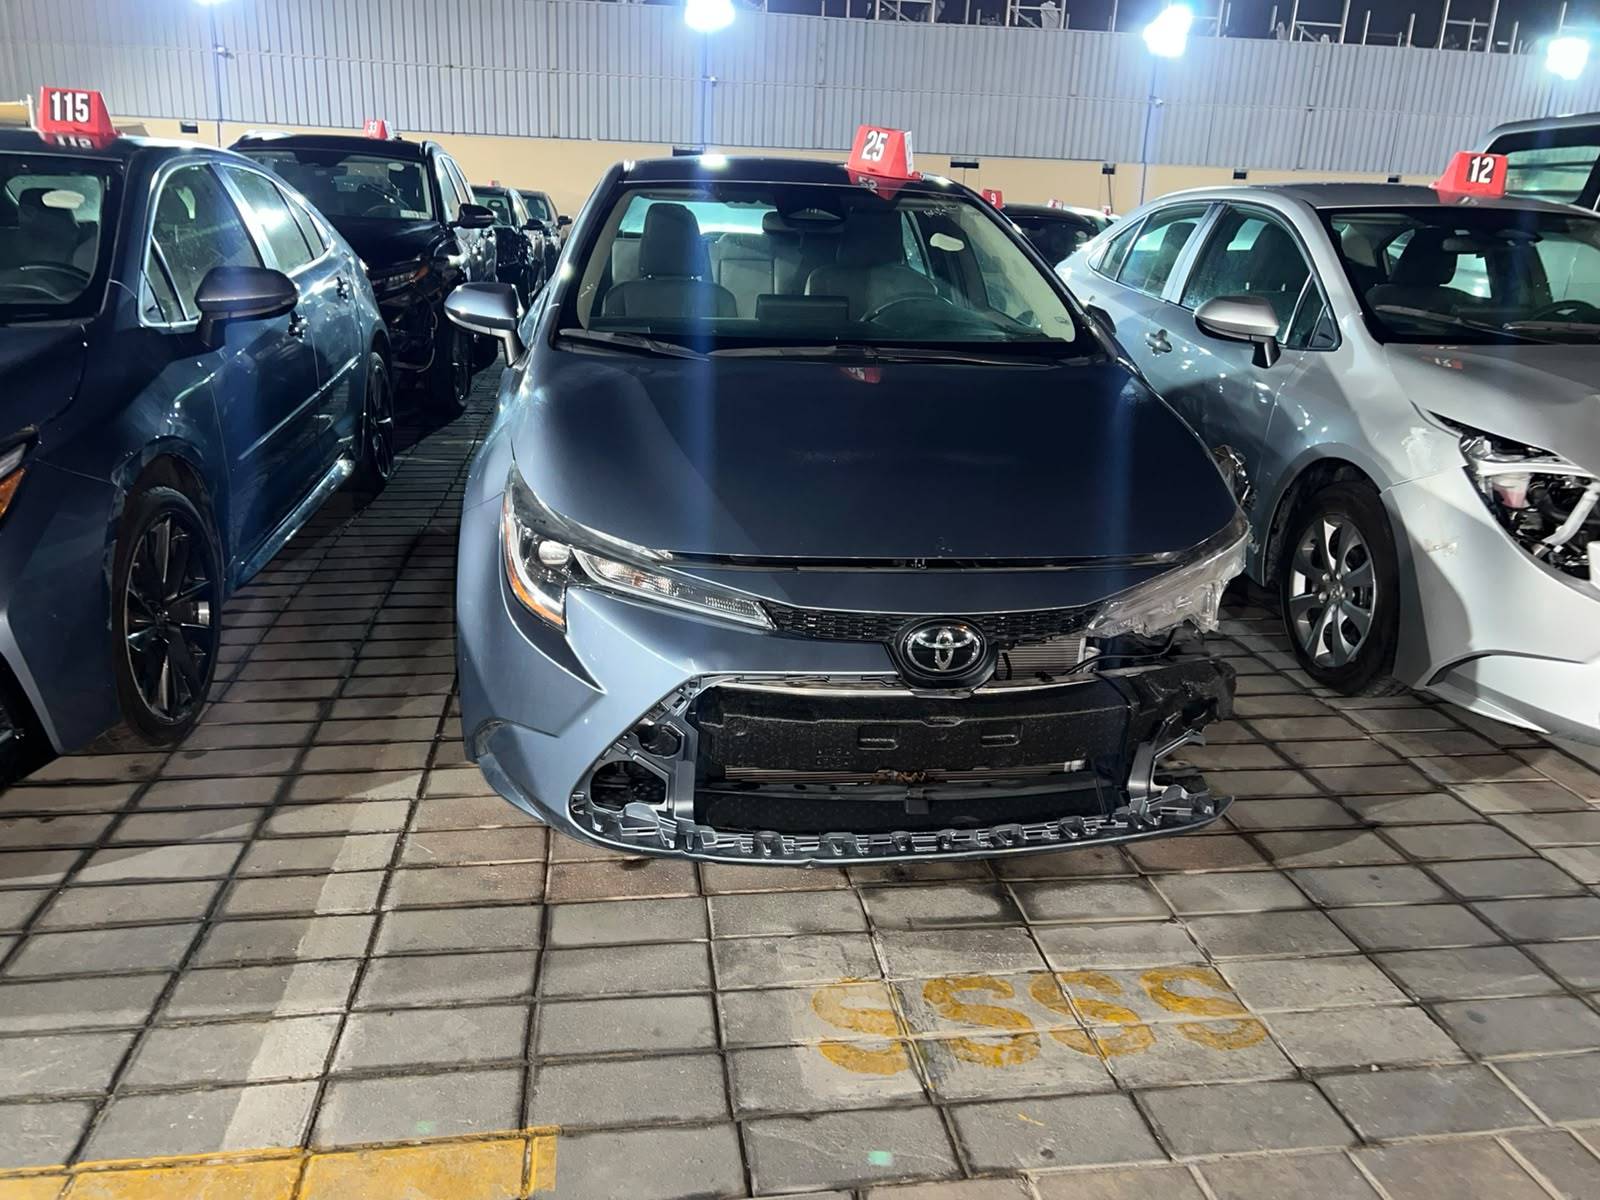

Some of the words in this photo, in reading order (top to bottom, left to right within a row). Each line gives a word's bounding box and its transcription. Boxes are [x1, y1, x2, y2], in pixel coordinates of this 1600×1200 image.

[51, 91, 89, 122] 115
[861, 130, 889, 162] 25
[1470, 155, 1495, 184] 12
